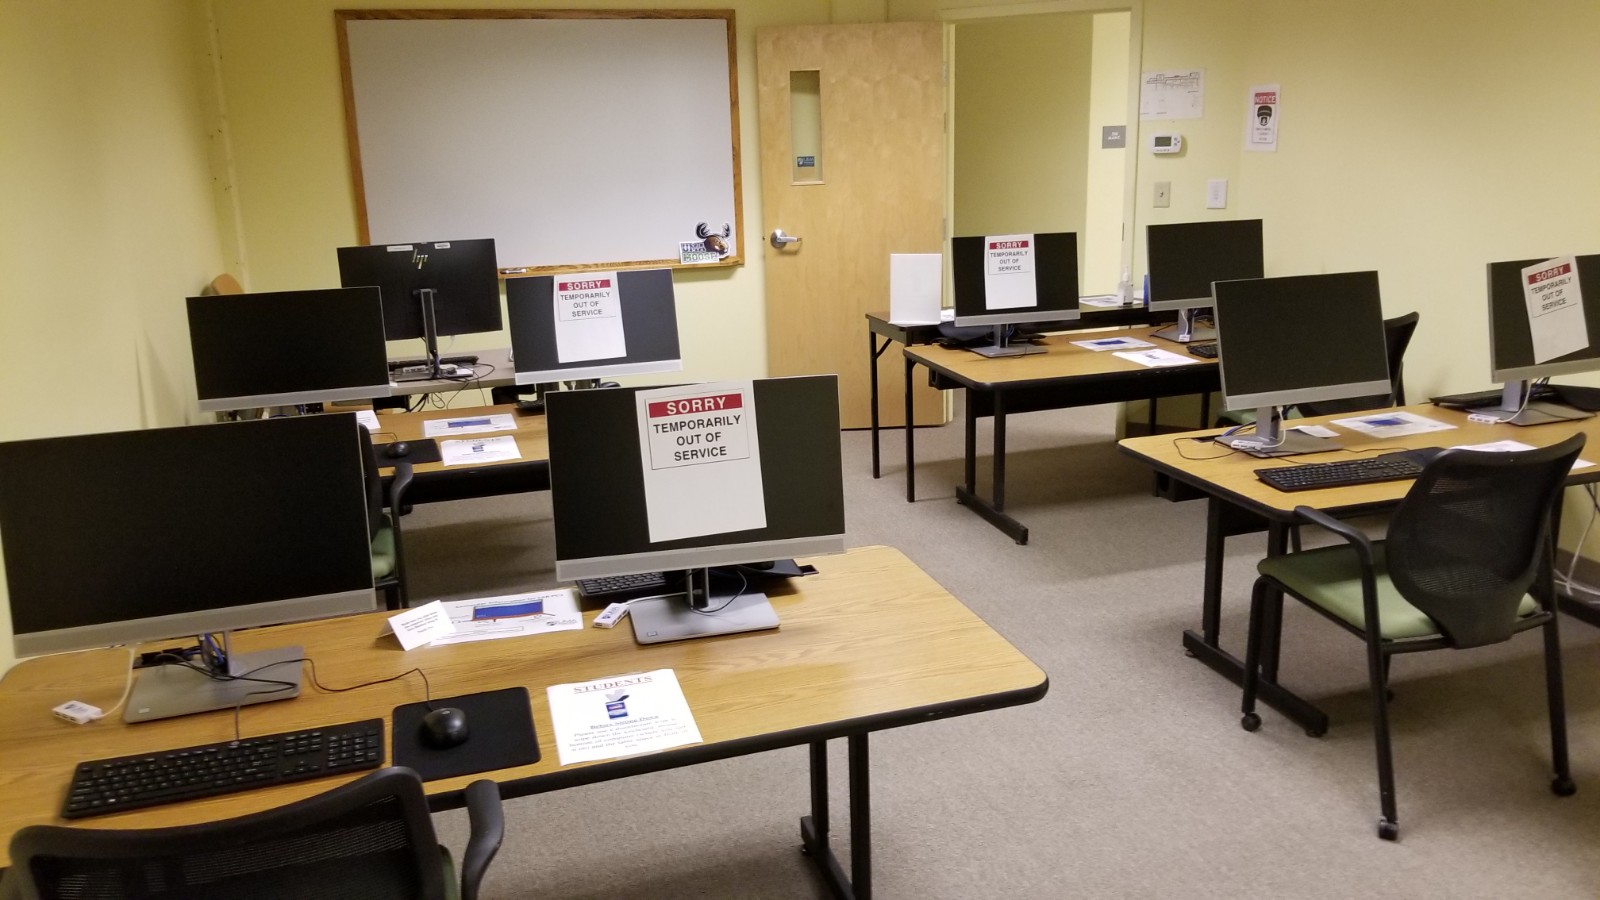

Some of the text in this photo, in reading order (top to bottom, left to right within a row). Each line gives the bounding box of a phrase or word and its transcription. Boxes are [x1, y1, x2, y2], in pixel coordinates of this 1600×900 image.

[1256, 95, 1276, 103] NOTICE
[996, 241, 1022, 249] SORRY
[683, 252, 717, 262] MOOSE
[1535, 266, 1564, 282] SORRY
[567, 280, 602, 291] SORRY
[1531, 277, 1571, 295] TEMPORARILY
[560, 291, 610, 301] TEMPORARILY
[1542, 289, 1563, 301] OUT OF
[1542, 298, 1567, 311] SERVICE
[572, 309, 602, 317] SERVICE
[667, 397, 726, 415] SORRY
[653, 414, 741, 434] TEMPORARILY
[676, 432, 722, 446] OUT OF
[674, 446, 727, 462] SERVICE
[574, 676, 653, 693] STUDENTS
